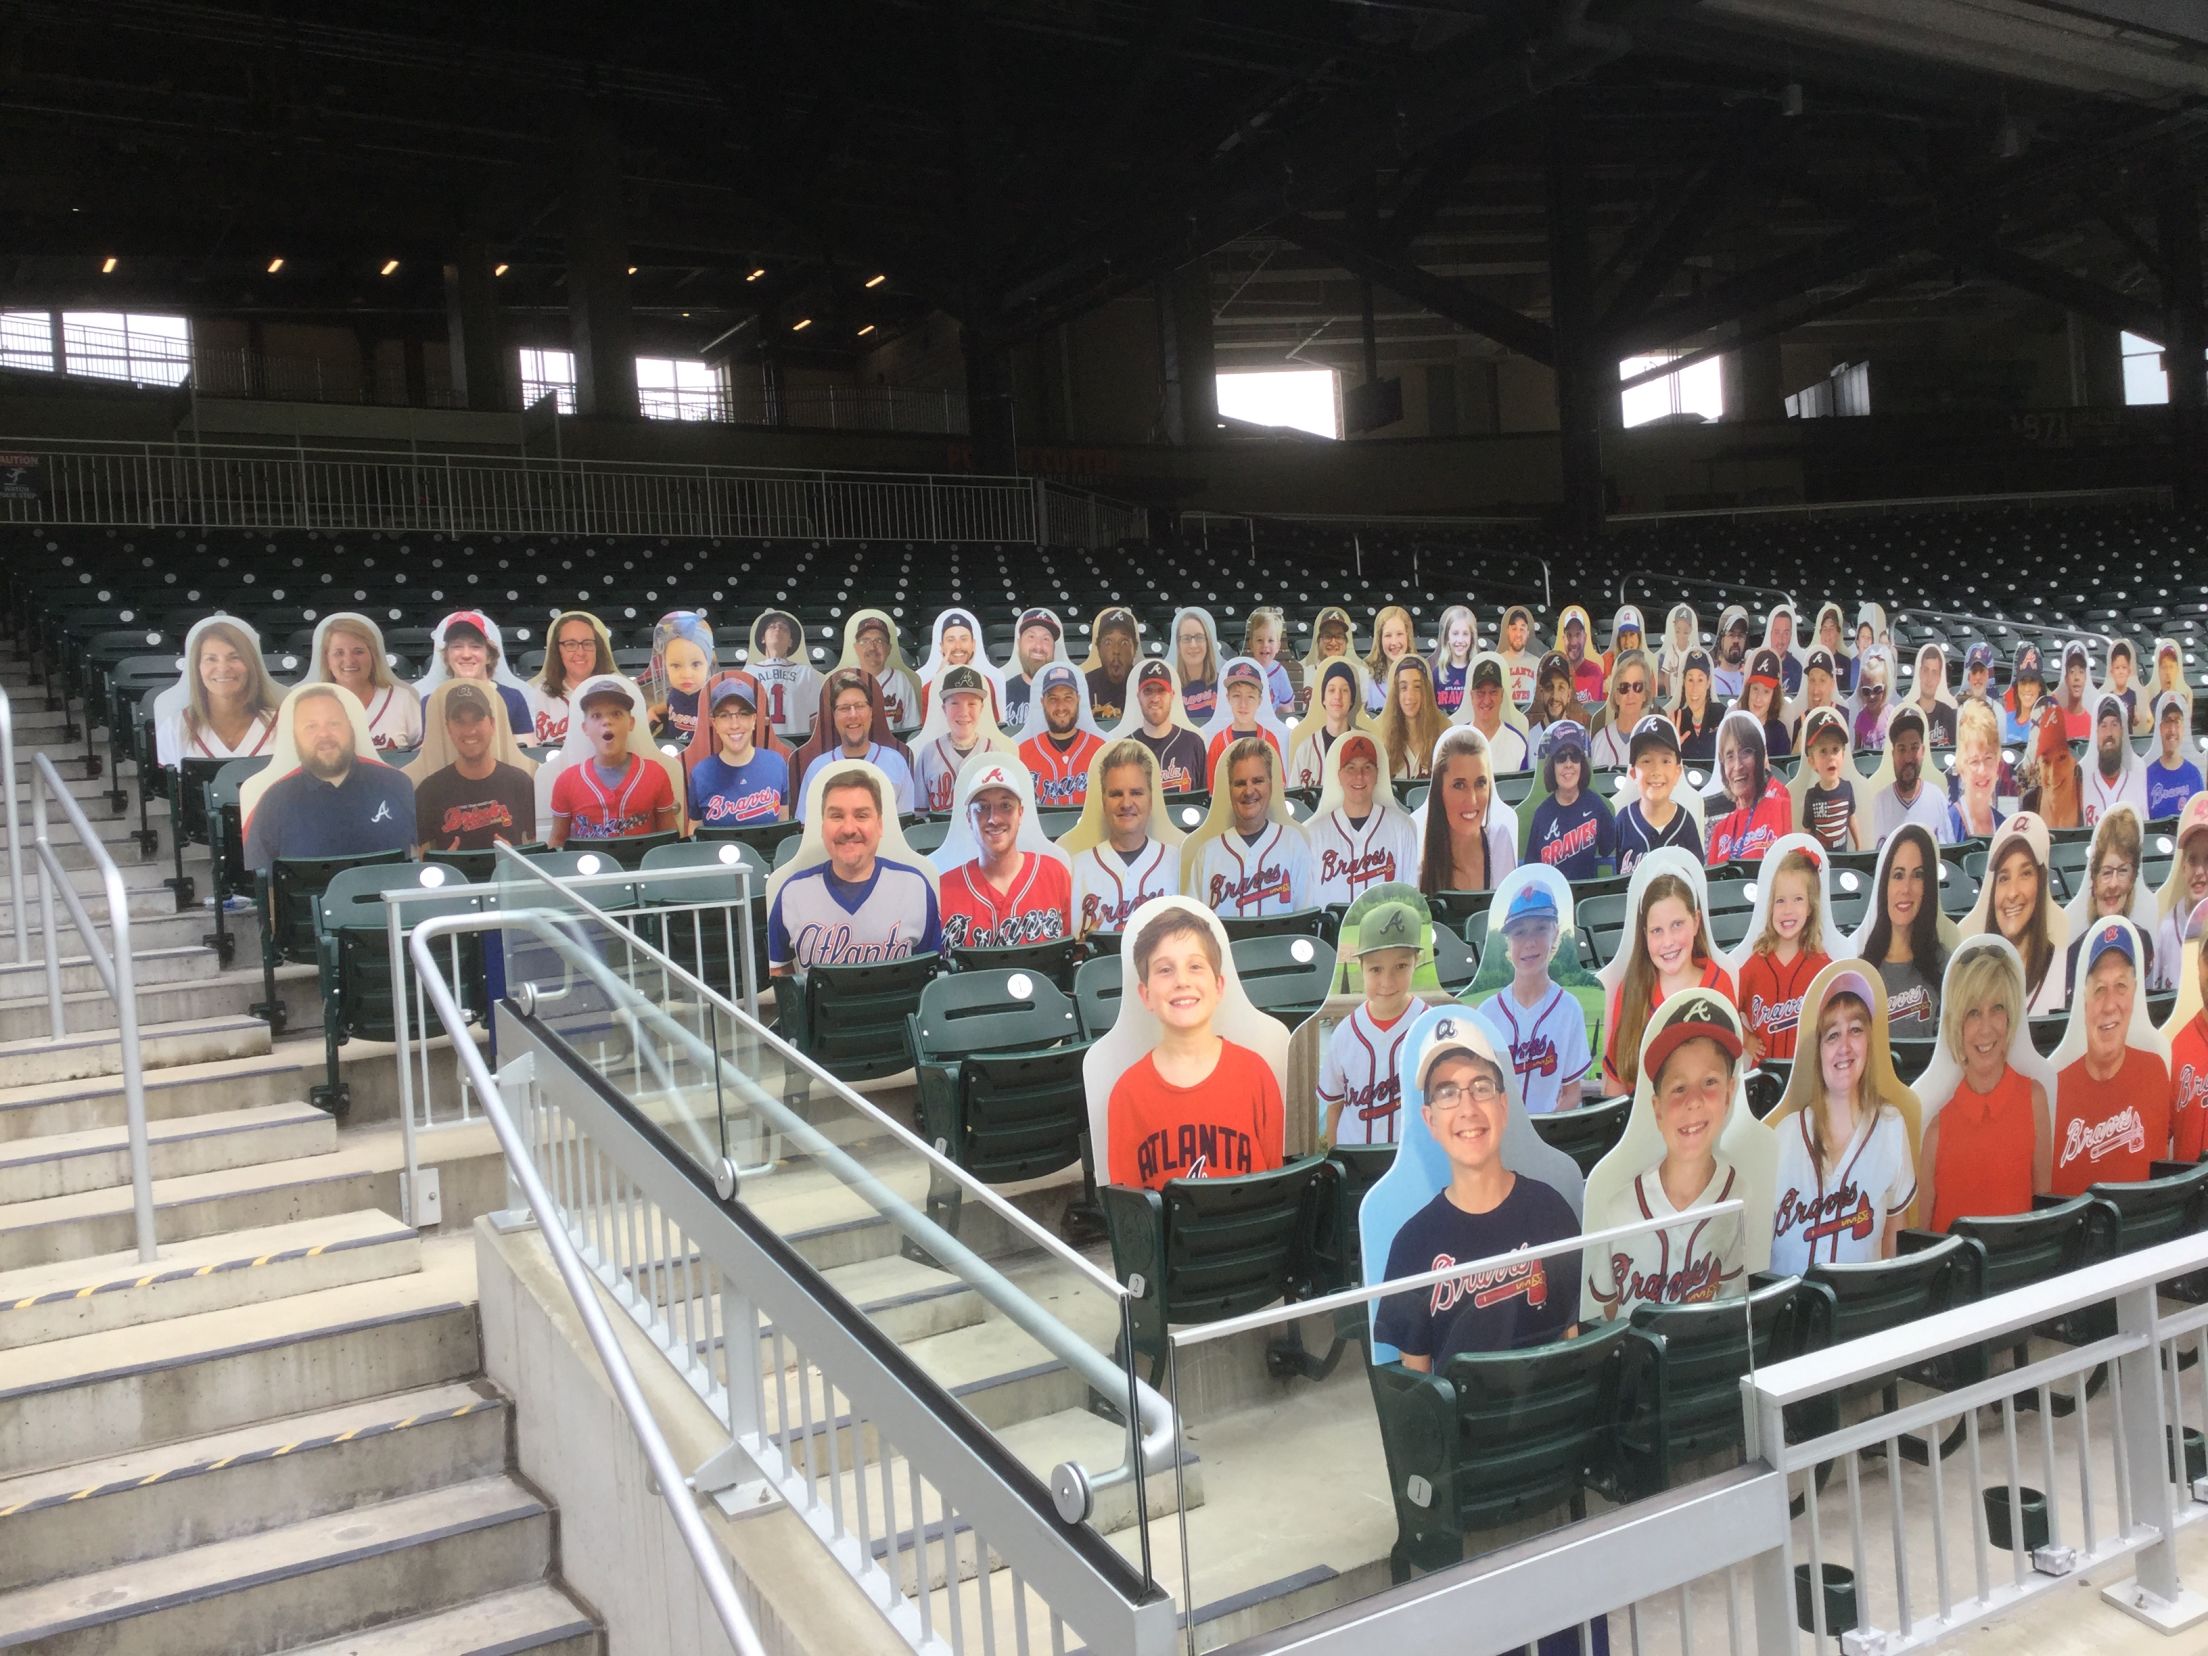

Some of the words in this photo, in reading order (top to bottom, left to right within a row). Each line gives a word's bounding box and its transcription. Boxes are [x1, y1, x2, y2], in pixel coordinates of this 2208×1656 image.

[0, 456, 39, 465] AUTION
[757, 669, 797, 683] ALBIES
[770, 683, 786, 724] 1
[1640, 715, 1658, 732] A
[982, 767, 1004, 784] A
[371, 800, 393, 822] A
[706, 786, 772, 821] Braves
[1541, 818, 1597, 867] BRAVES
[1544, 817, 1561, 841] A
[1321, 847, 1386, 886] Braves
[1209, 863, 1281, 910] Braves
[1380, 910, 1405, 935] A
[796, 919, 912, 969] Atlanta
[1683, 1000, 1711, 1023] A
[1137, 1123, 1251, 1182] ATLANTA
[2060, 1105, 2134, 1169] Braves
[1774, 1180, 1858, 1240] Braves
